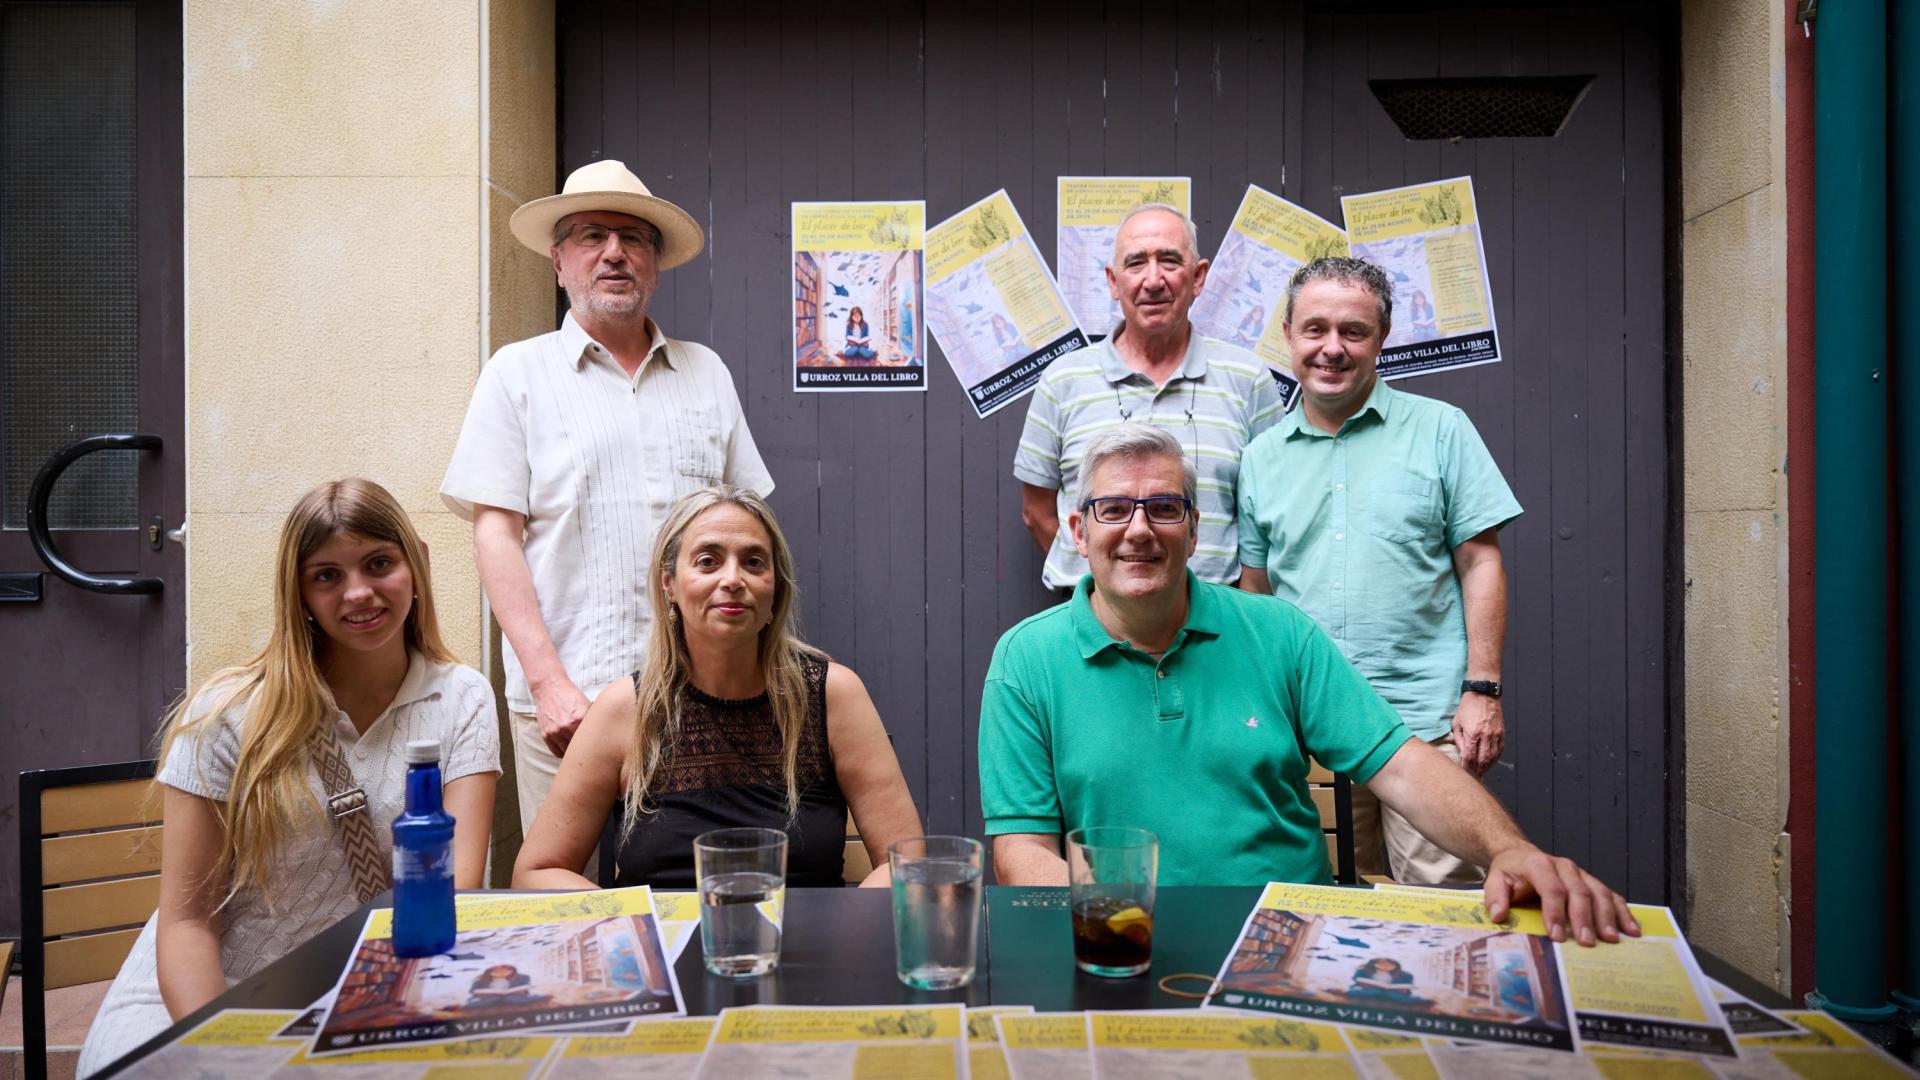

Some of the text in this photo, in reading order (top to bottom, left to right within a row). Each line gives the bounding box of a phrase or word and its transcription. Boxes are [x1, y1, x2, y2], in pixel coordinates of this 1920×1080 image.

[983, 374, 1012, 395] URROZ
[1011, 361, 1037, 379] VILLA
[1036, 352, 1054, 367] DEL
[1053, 337, 1080, 356] LIBRO
[1381, 351, 1412, 363] URROZ
[1413, 346, 1440, 358] VILLA
[1441, 343, 1460, 353] DEL
[1461, 339, 1490, 350] LIBRO
[810, 373, 919, 381] URROZ VILLA DEL LIBRO
[357, 1001, 661, 1043] URROZ VILLA DEL LIBRO
[1247, 996, 1554, 1043] URROZ VILLA DEL LIBRO
[1625, 1023, 1709, 1041] LIBRO
